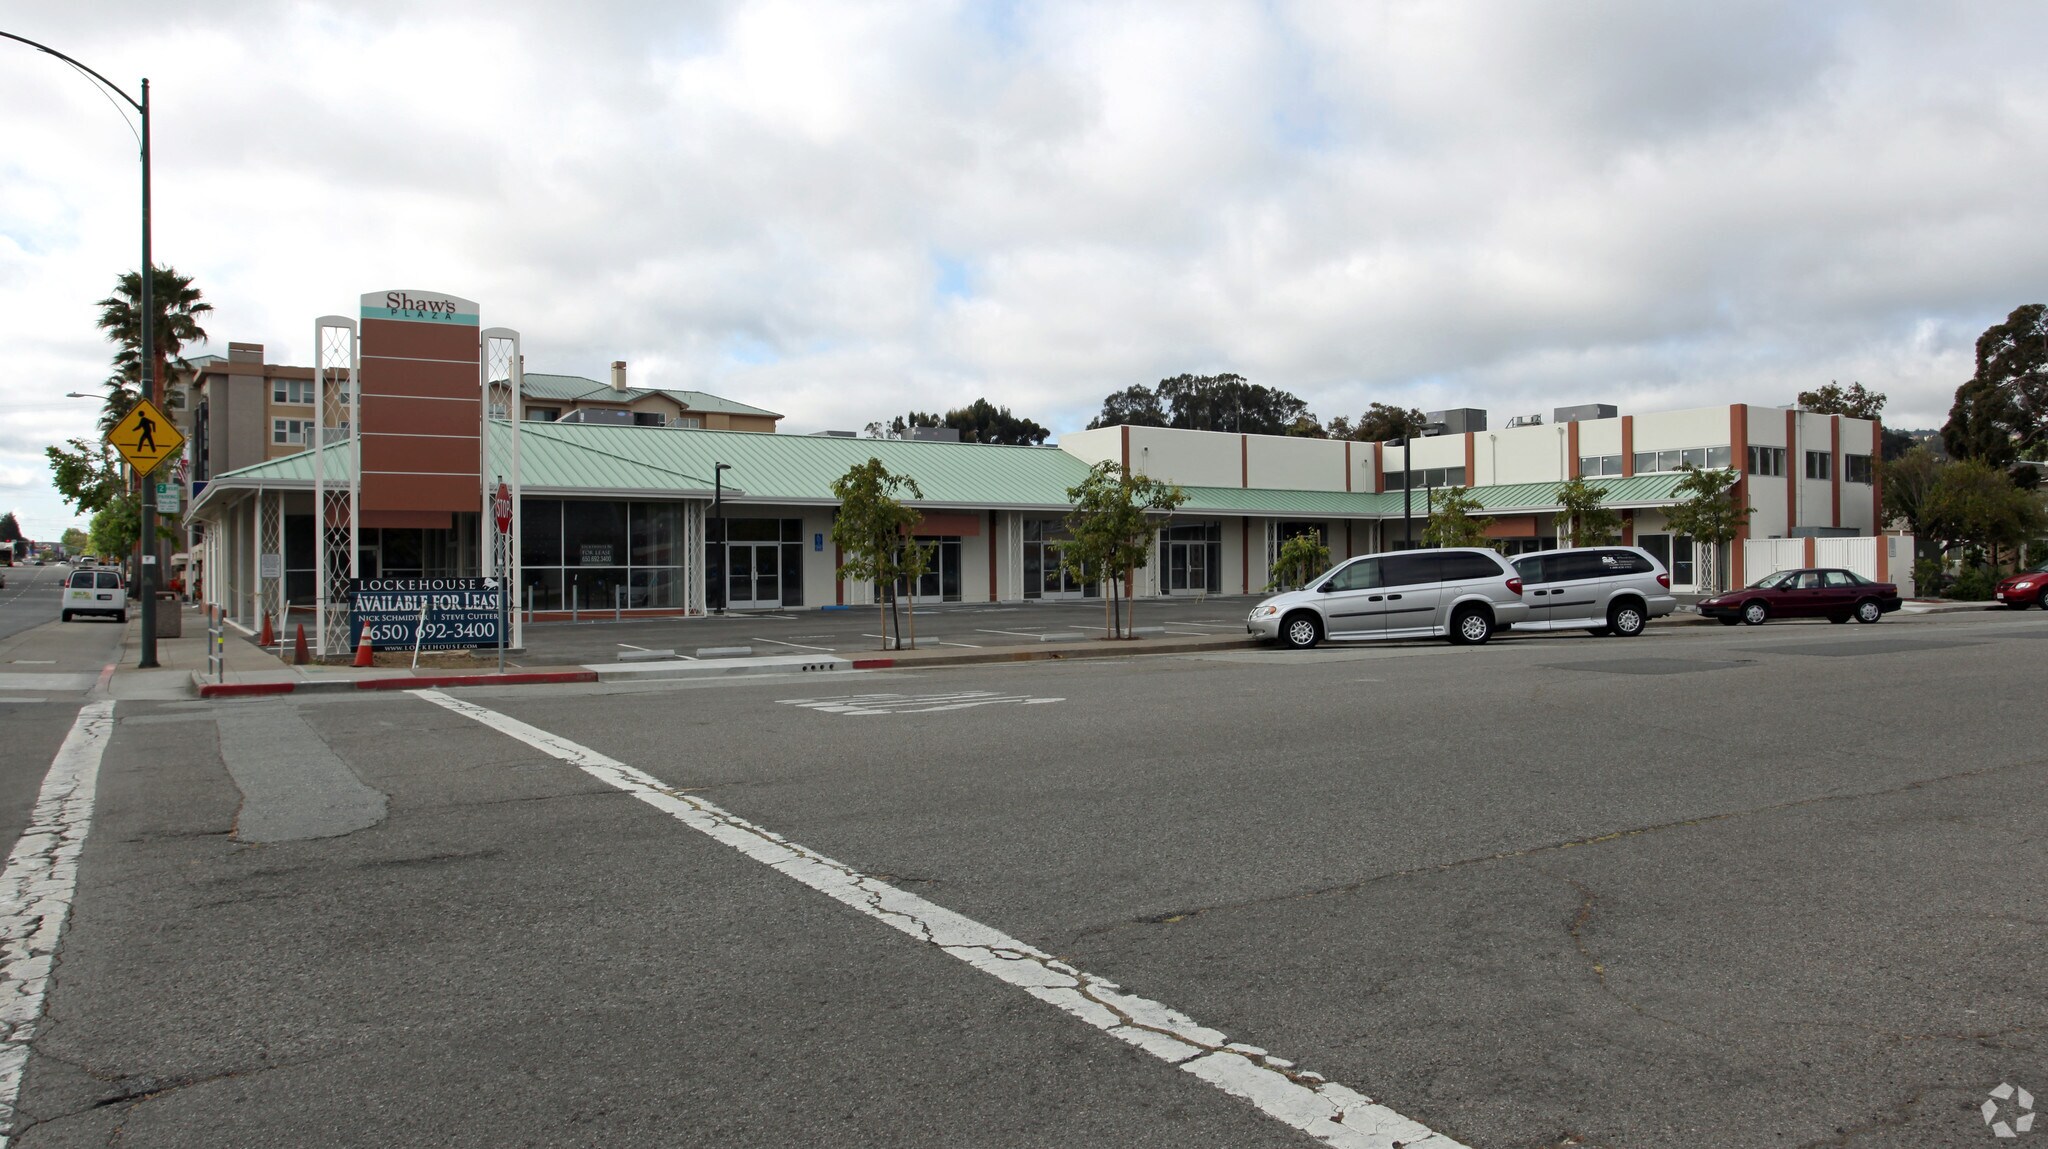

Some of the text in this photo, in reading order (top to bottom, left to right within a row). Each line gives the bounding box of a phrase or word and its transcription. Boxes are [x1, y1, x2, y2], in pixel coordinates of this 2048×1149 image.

[387, 292, 456, 313] Shaw's
[391, 308, 452, 320] PLAZA
[496, 499, 511, 518] STOP
[360, 579, 476, 591] LOCKEHOUSE
[432, 594, 462, 611] FOR
[358, 614, 380, 622] NICK
[441, 613, 465, 621] STEVE
[467, 612, 499, 620] CUTTER
[370, 622, 495, 641] 650) 692-3400
